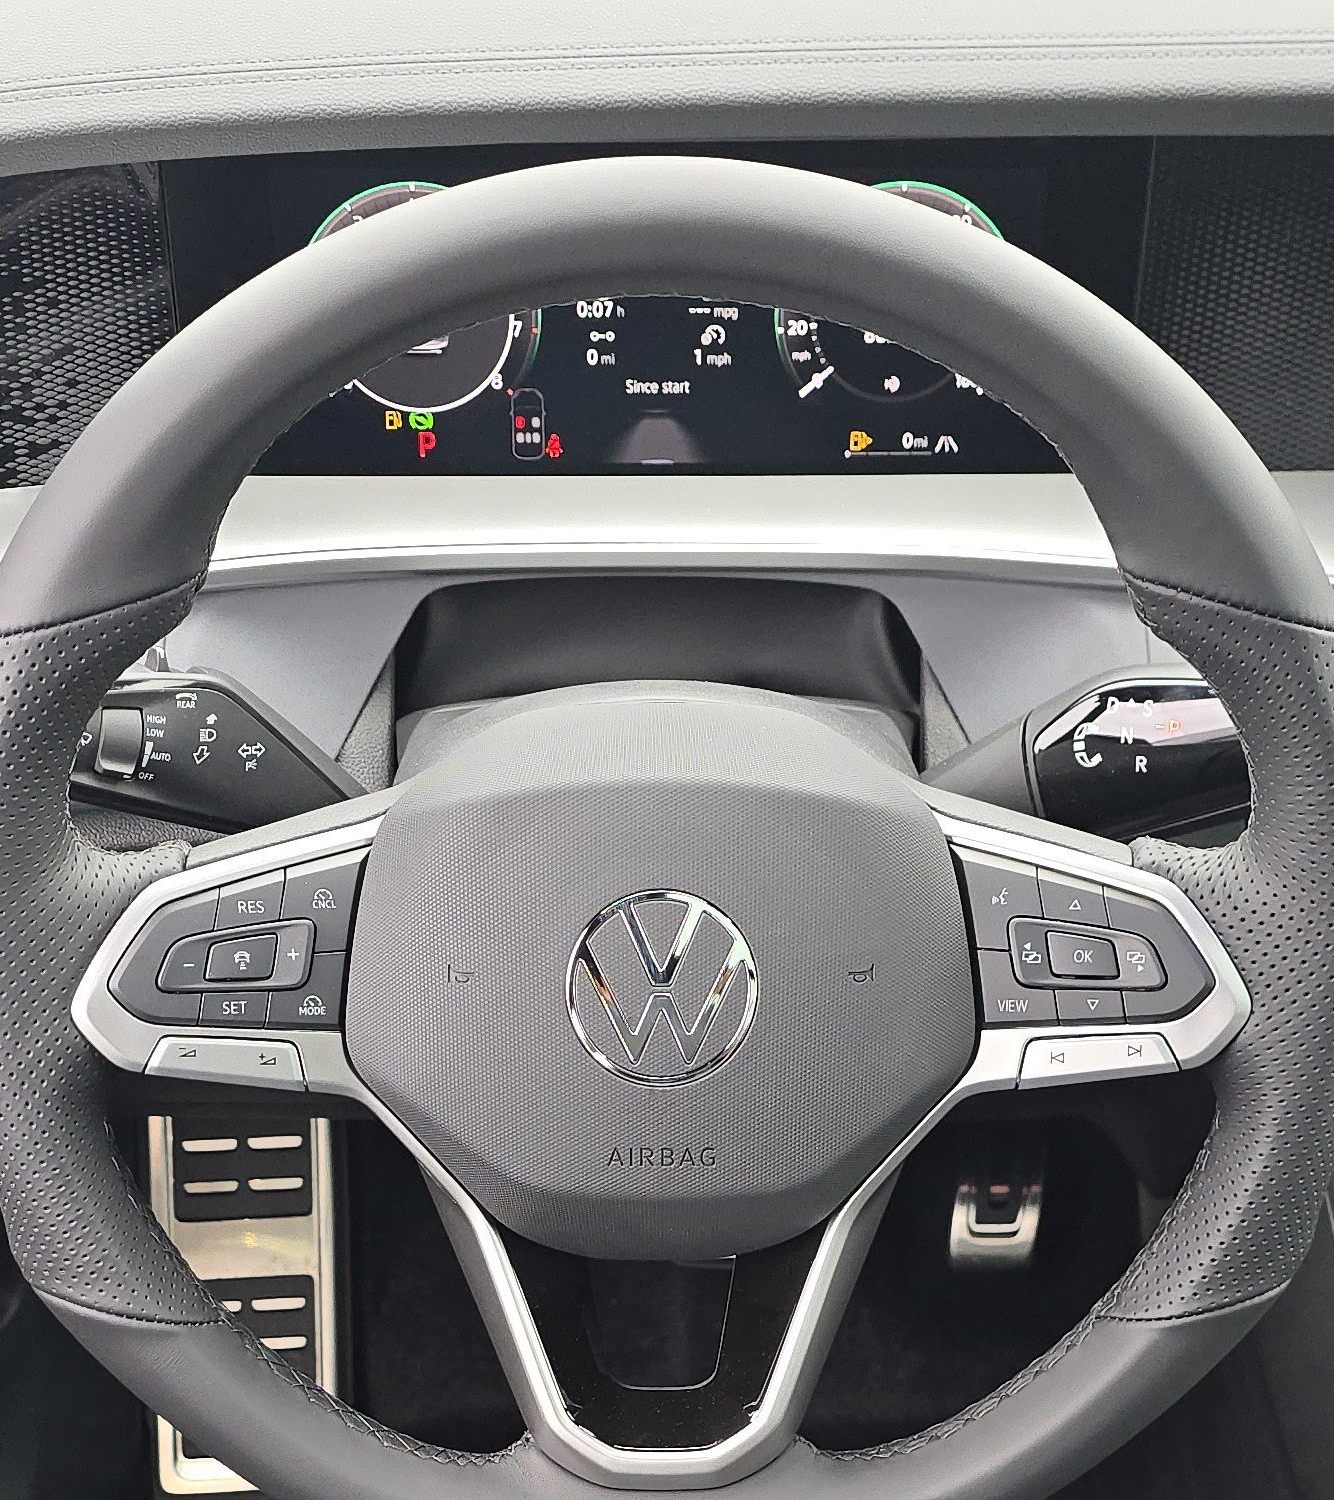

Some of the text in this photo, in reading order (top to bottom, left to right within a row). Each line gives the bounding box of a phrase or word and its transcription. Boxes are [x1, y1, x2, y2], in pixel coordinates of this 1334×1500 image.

[576, 300, 625, 318] 0:07 h
[713, 306, 739, 320] mpg
[514, 320, 523, 338] 7
[787, 319, 808, 336] 20
[586, 348, 616, 366] 0 mi
[693, 348, 732, 367] 1 mph
[492, 373, 503, 390] 8
[625, 378, 690, 394] Since start
[176, 701, 196, 709] REAR
[1107, 697, 1154, 717] D S
[146, 715, 167, 725] HIGH
[146, 728, 164, 738] LOW
[1120, 727, 1133, 744] N
[150, 752, 171, 762] AUTO
[1135, 756, 1147, 773] R
[138, 772, 155, 781] OFF
[237, 900, 265, 914] RES
[312, 899, 336, 909] CNCL
[1073, 950, 1093, 963] OK
[222, 1001, 247, 1015] SET
[299, 1005, 326, 1016] MODE
[997, 1000, 1028, 1013] VIEW
[607, 1147, 718, 1168] AIRBAG
